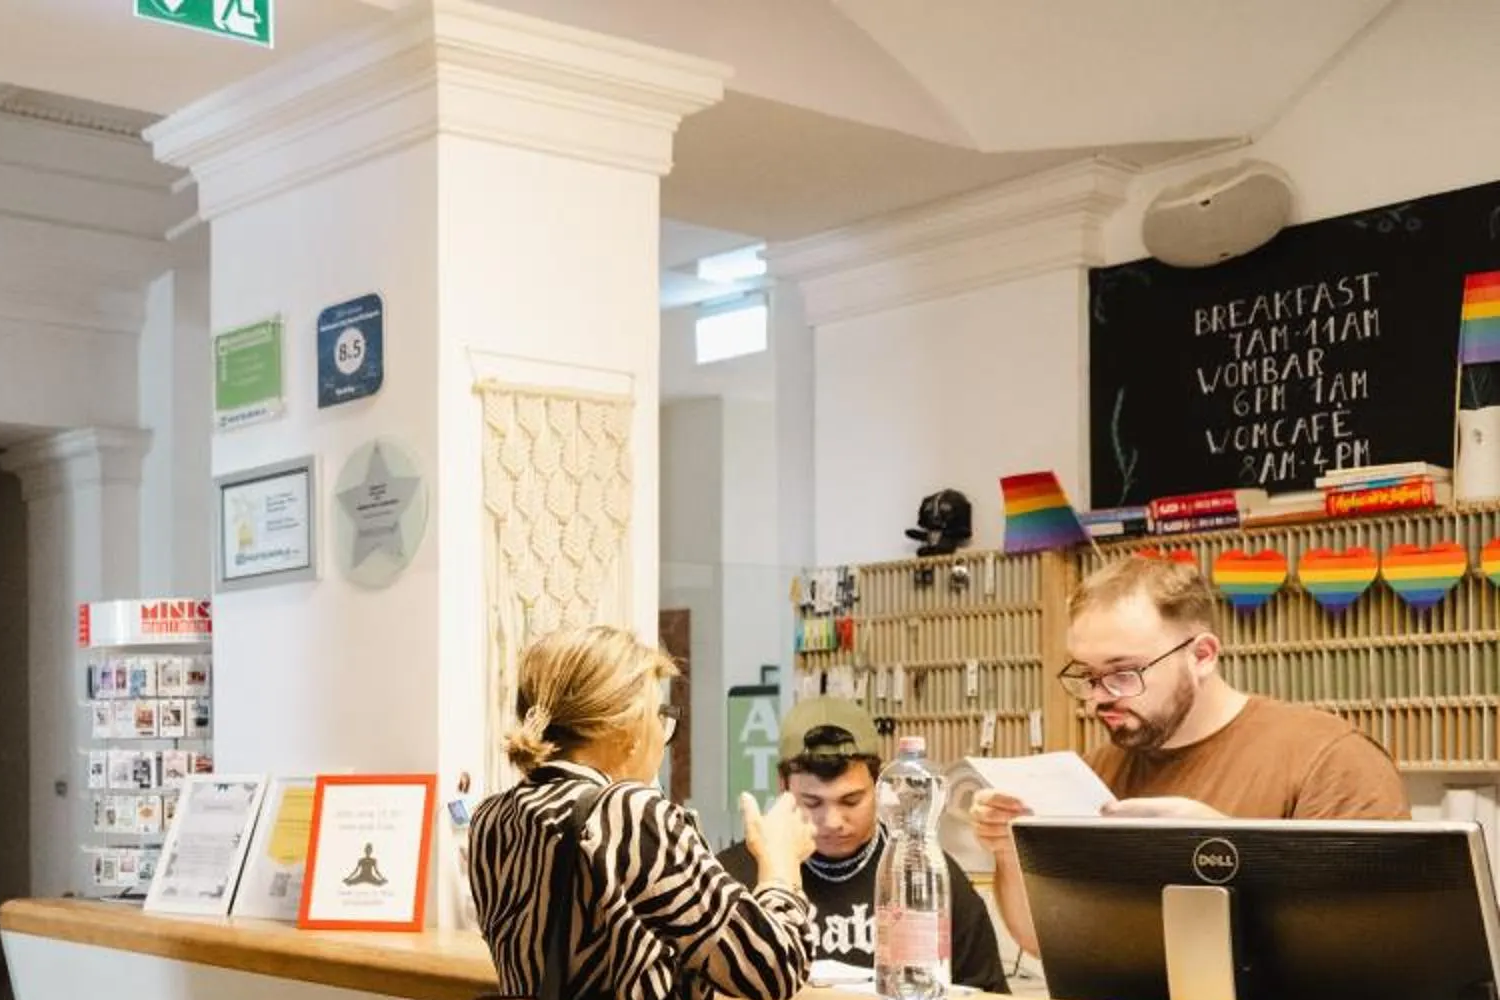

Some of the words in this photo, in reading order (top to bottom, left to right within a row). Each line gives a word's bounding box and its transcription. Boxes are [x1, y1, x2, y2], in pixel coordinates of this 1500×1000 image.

[1194, 271, 1379, 336] BREAKFAST
[338, 340, 361, 362] 8.5
[1197, 347, 1325, 395] WOMBAR
[739, 696, 780, 815] AT
[1198, 854, 1234, 867] DELL
